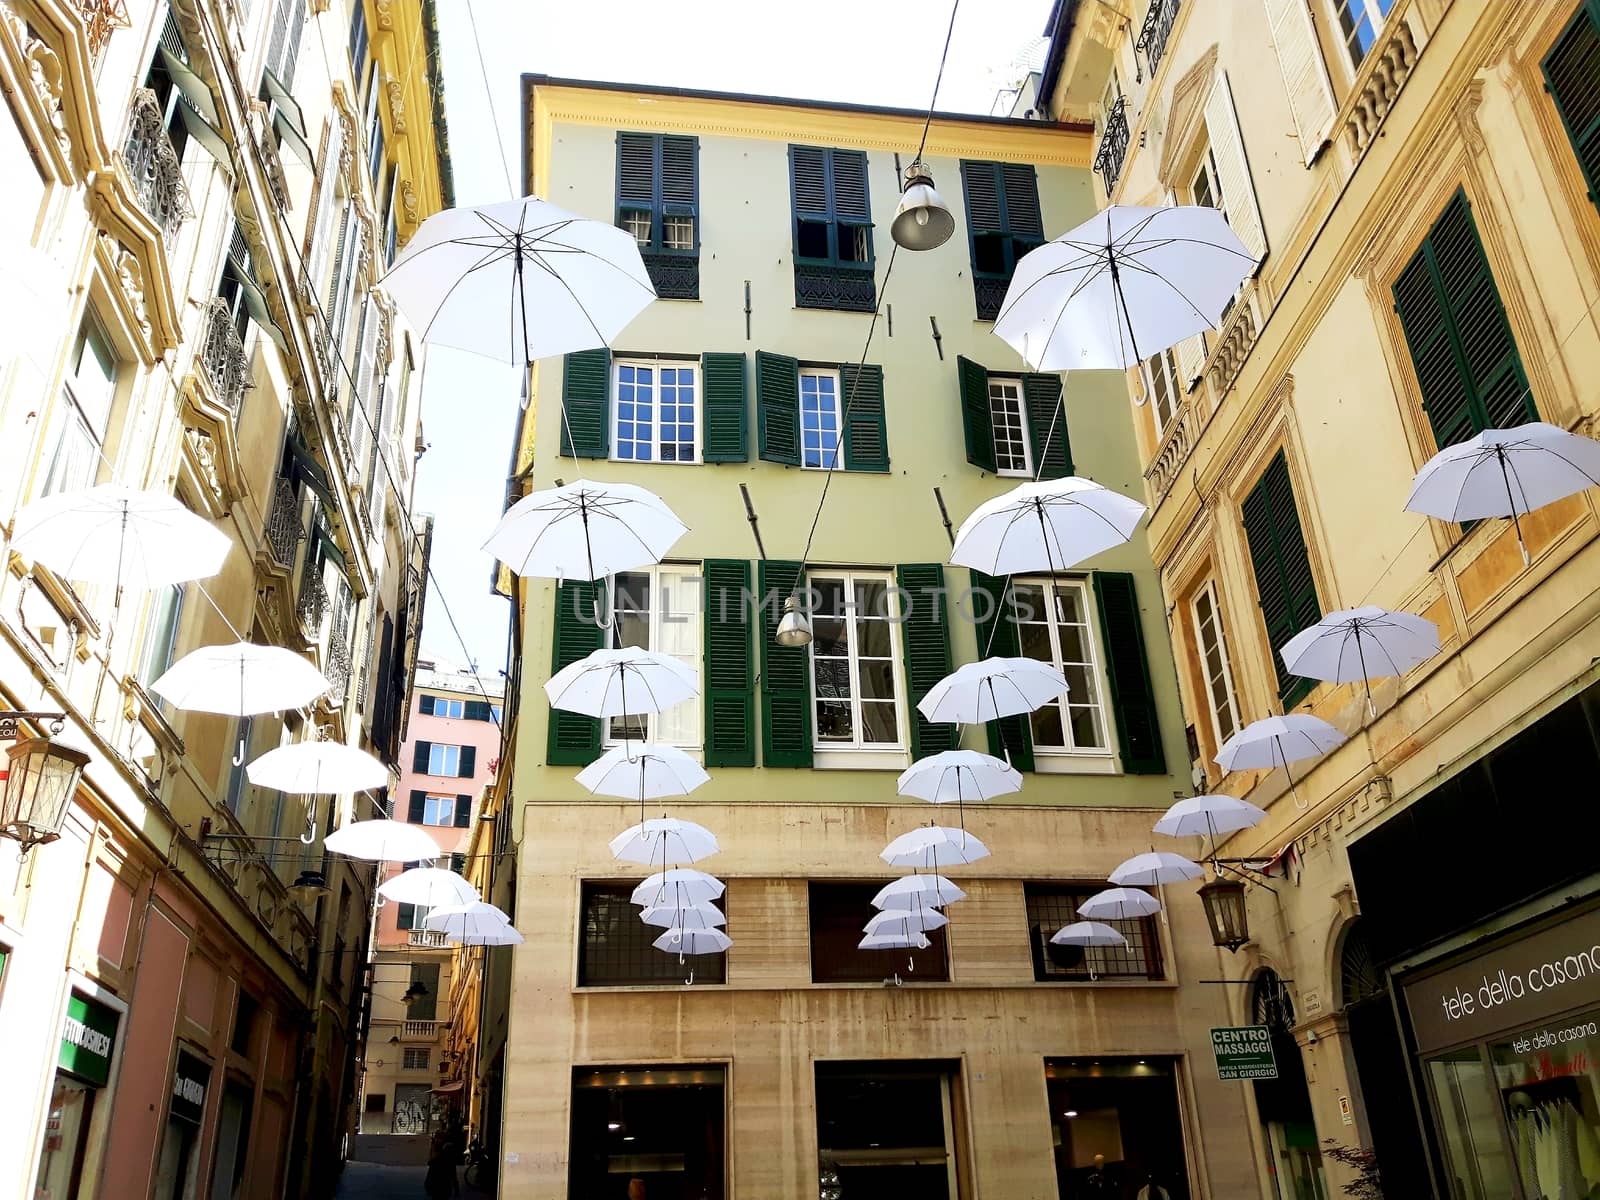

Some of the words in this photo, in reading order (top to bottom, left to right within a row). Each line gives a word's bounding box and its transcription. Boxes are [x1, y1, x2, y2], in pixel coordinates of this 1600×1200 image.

[1442, 986, 1475, 1021] tele
[1479, 969, 1525, 1009] della
[1213, 1029, 1267, 1042] CENTRO
[1513, 1037, 1531, 1054] tele
[1533, 1030, 1557, 1049] della
[1559, 1022, 1597, 1042] casana
[1215, 1042, 1271, 1055] MASSAGGI
[1220, 1070, 1238, 1078] SAN
[1239, 1069, 1276, 1077] GIORGIO
